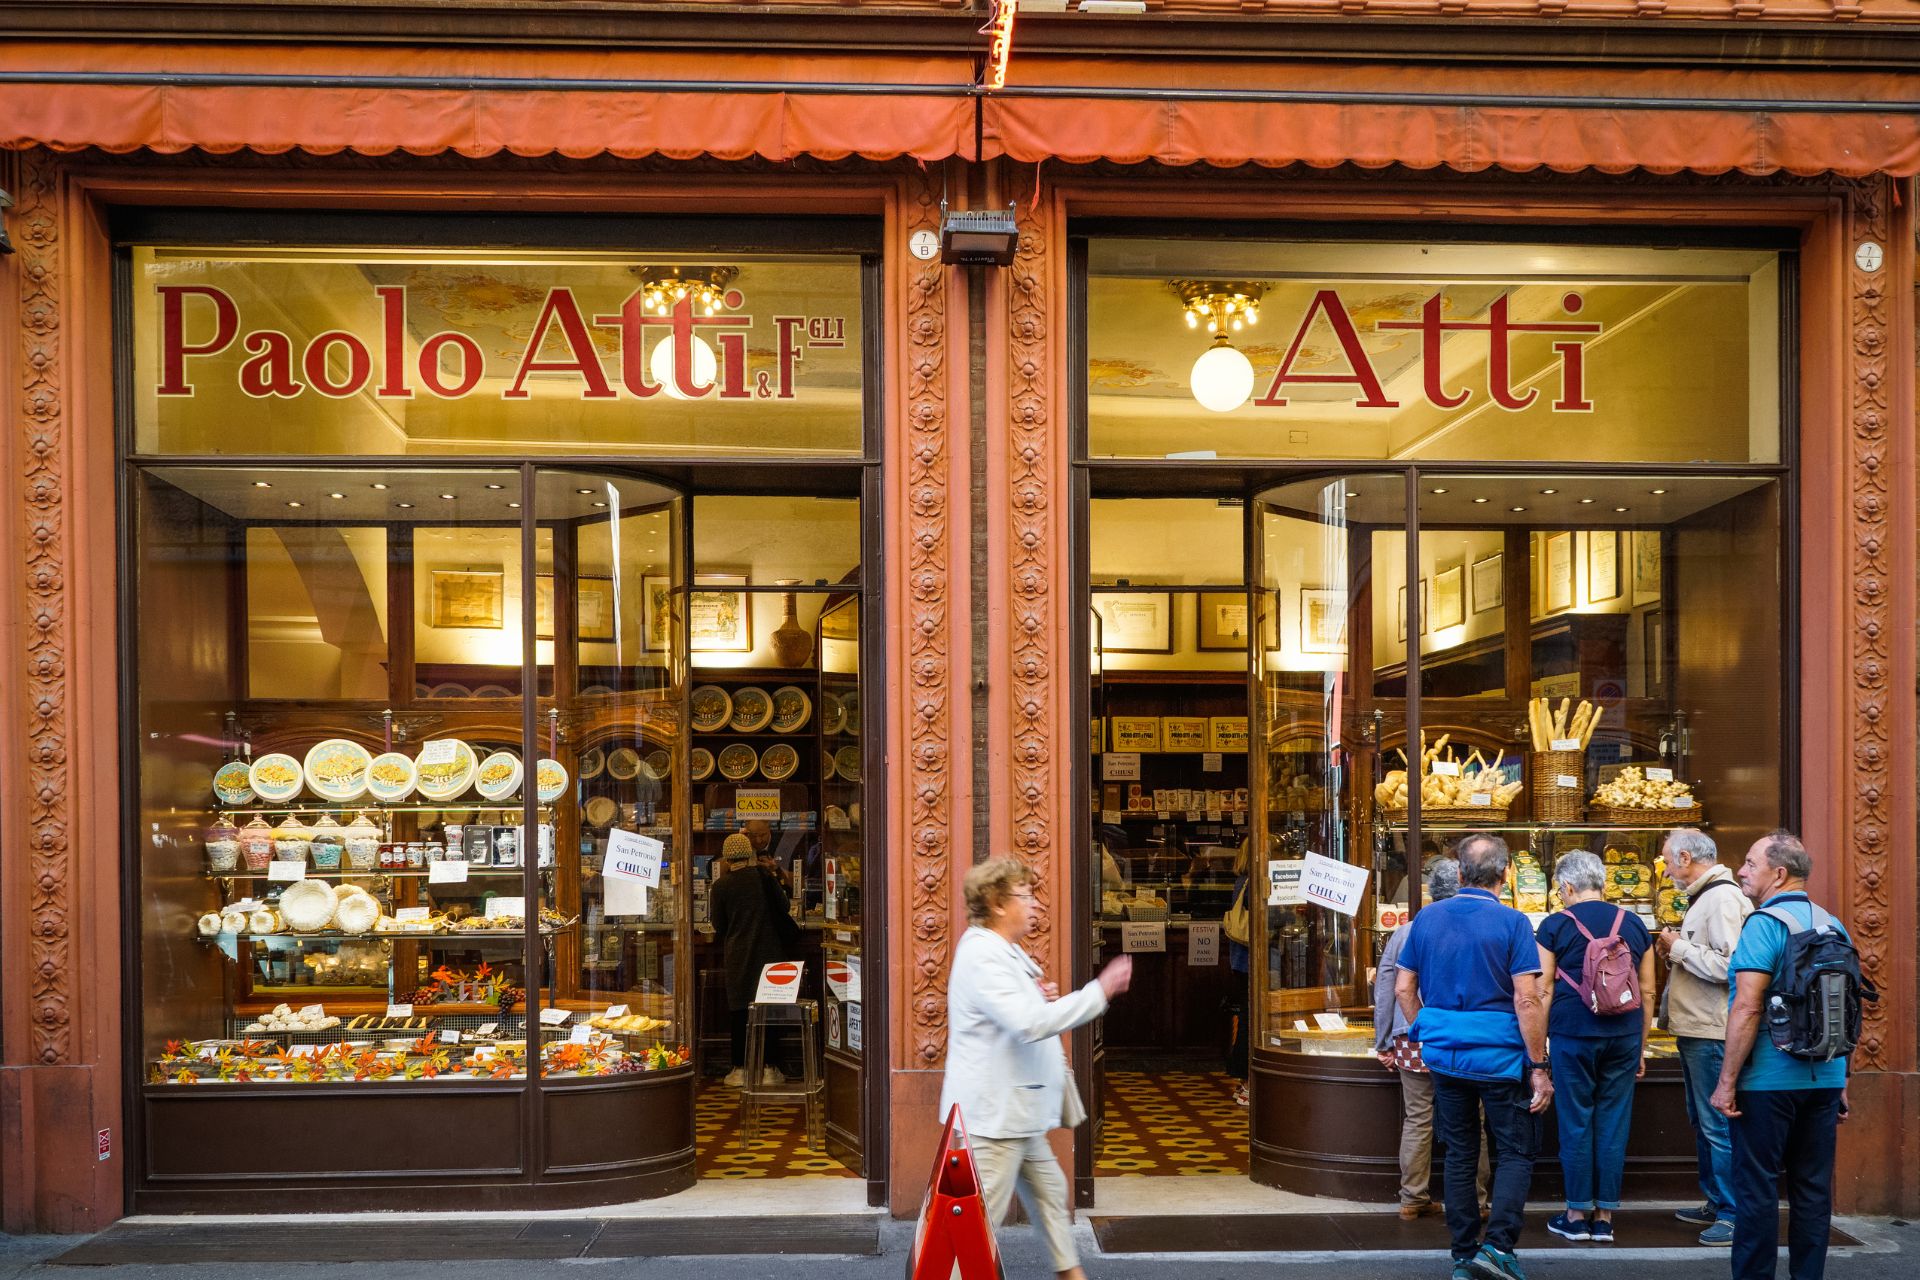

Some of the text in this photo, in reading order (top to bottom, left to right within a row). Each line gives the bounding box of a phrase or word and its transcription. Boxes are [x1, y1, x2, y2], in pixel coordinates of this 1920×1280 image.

[922, 233, 927, 243] 7
[921, 246, 929, 255] B
[1867, 246, 1872, 256] 7
[1866, 259, 1872, 268] A
[156, 283, 487, 400] Paolo
[502, 285, 754, 401] Atti
[1252, 288, 1604, 413] Atti
[737, 800, 778, 810] CASSA
[616, 845, 656, 862] San Petronio
[616, 861, 652, 877] CHIUSI
[1309, 868, 1354, 888] San Petronio
[1308, 883, 1348, 903] CHIUSI
